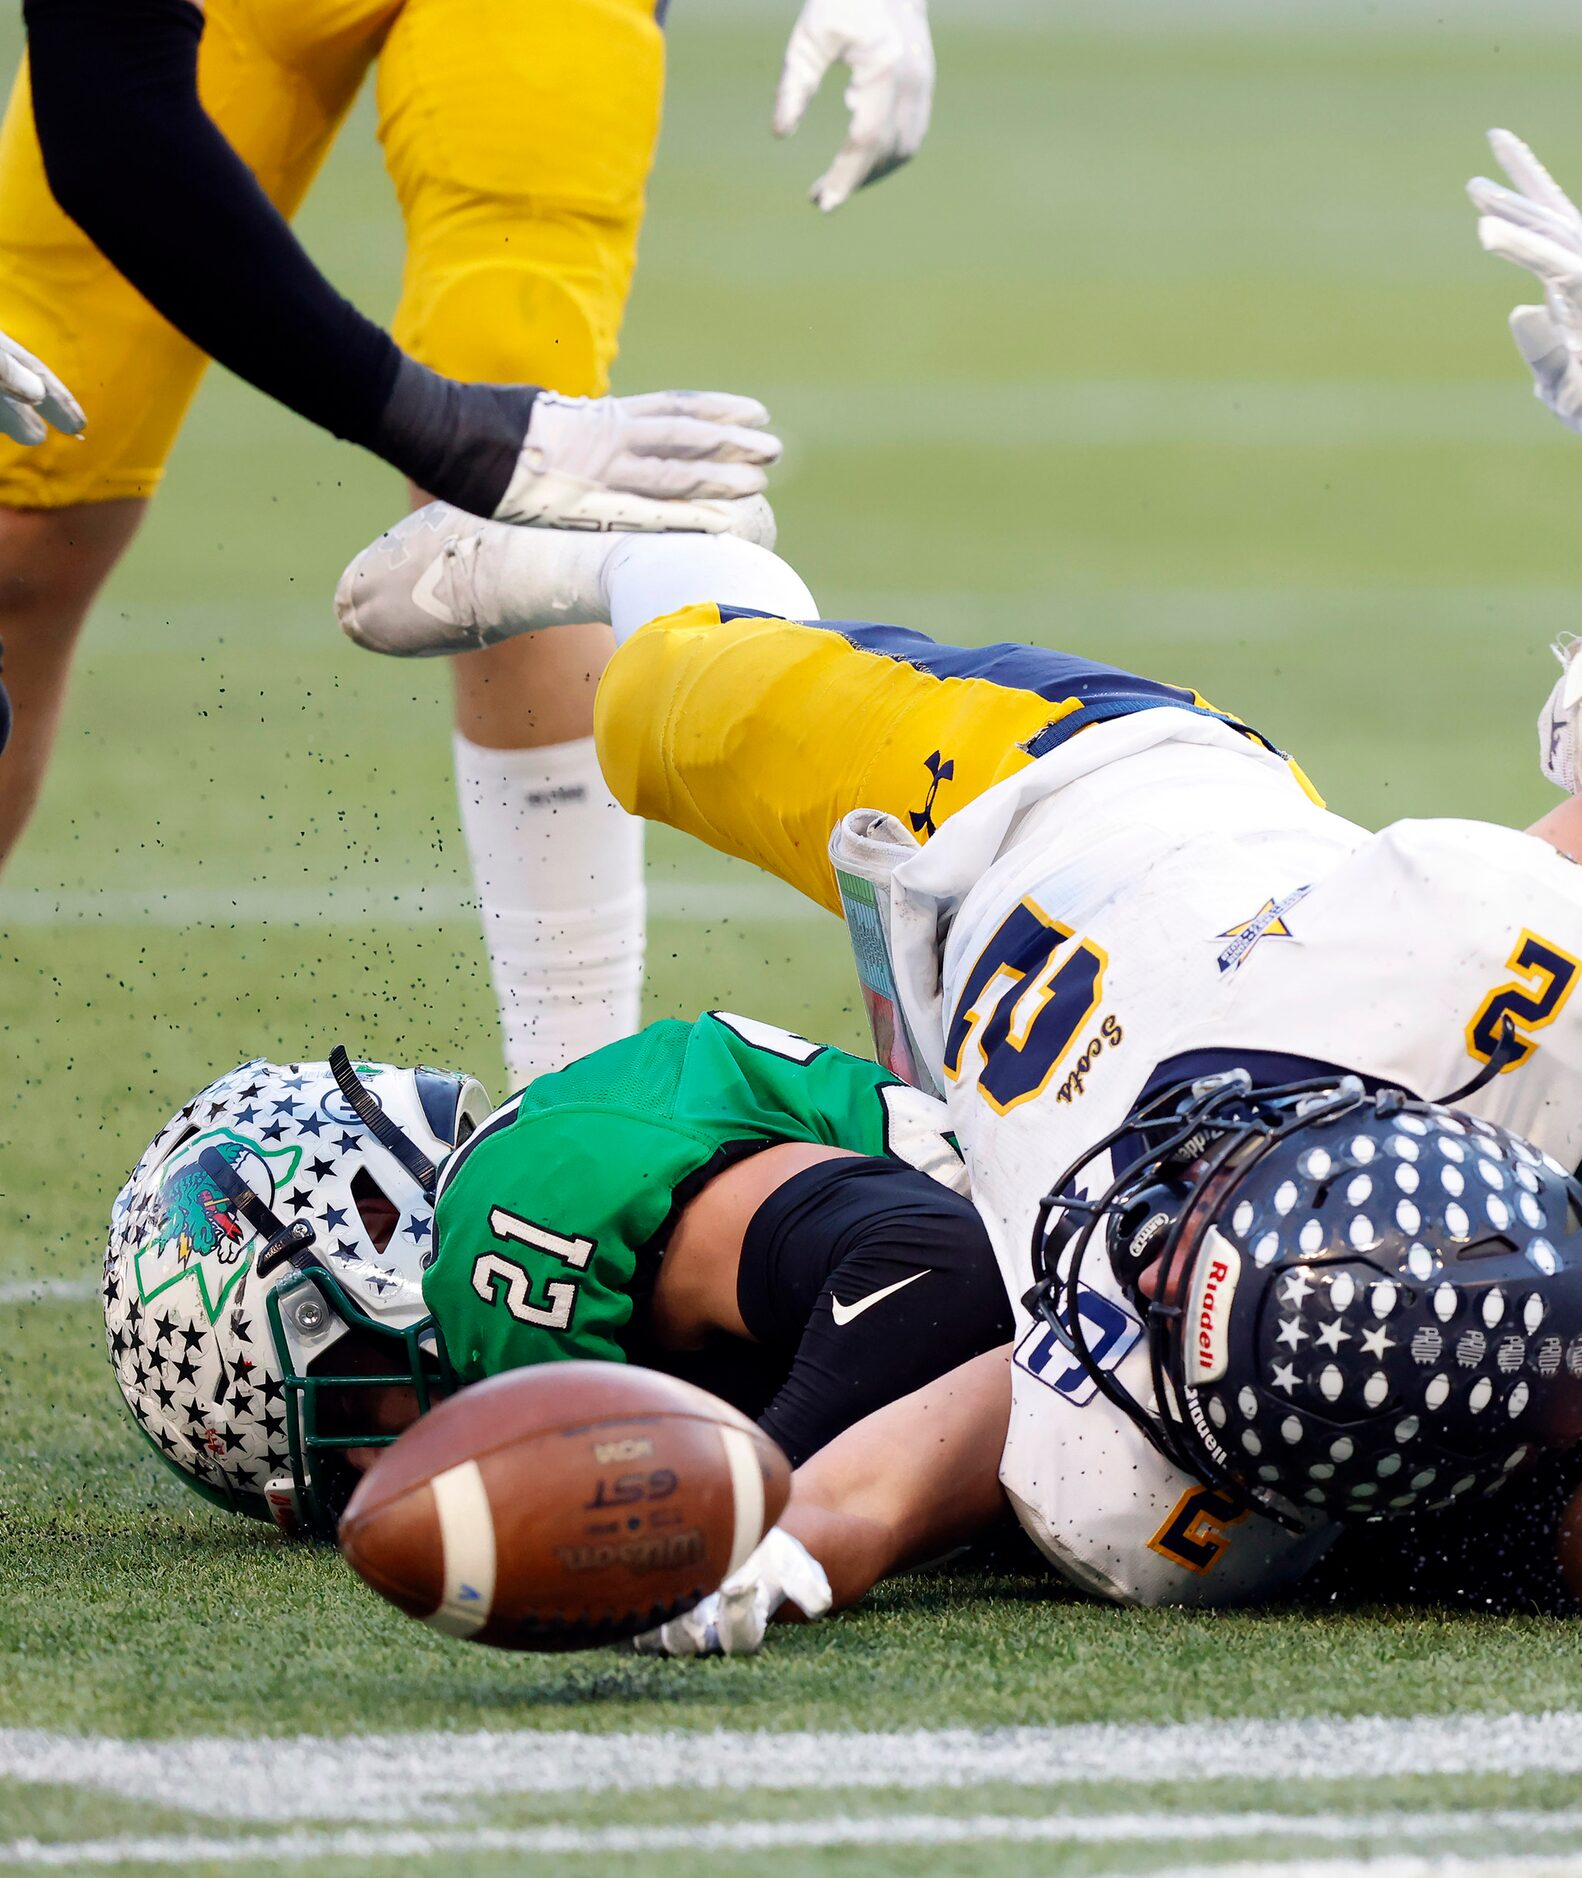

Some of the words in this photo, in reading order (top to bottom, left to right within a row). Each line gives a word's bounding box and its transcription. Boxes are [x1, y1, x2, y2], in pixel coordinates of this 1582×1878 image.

[942, 893, 1109, 1118] 2
[1055, 1014, 1124, 1104] Scots
[470, 1203, 599, 1333] 21
[1198, 1260, 1229, 1369] Riddell
[1410, 1326, 1443, 1365] PRIDE
[1455, 1329, 1487, 1369] PRIDE
[1497, 1335, 1526, 1375] PRIDE
[1538, 1337, 1563, 1376] PRIDE
[583, 1468, 679, 1511] GST
